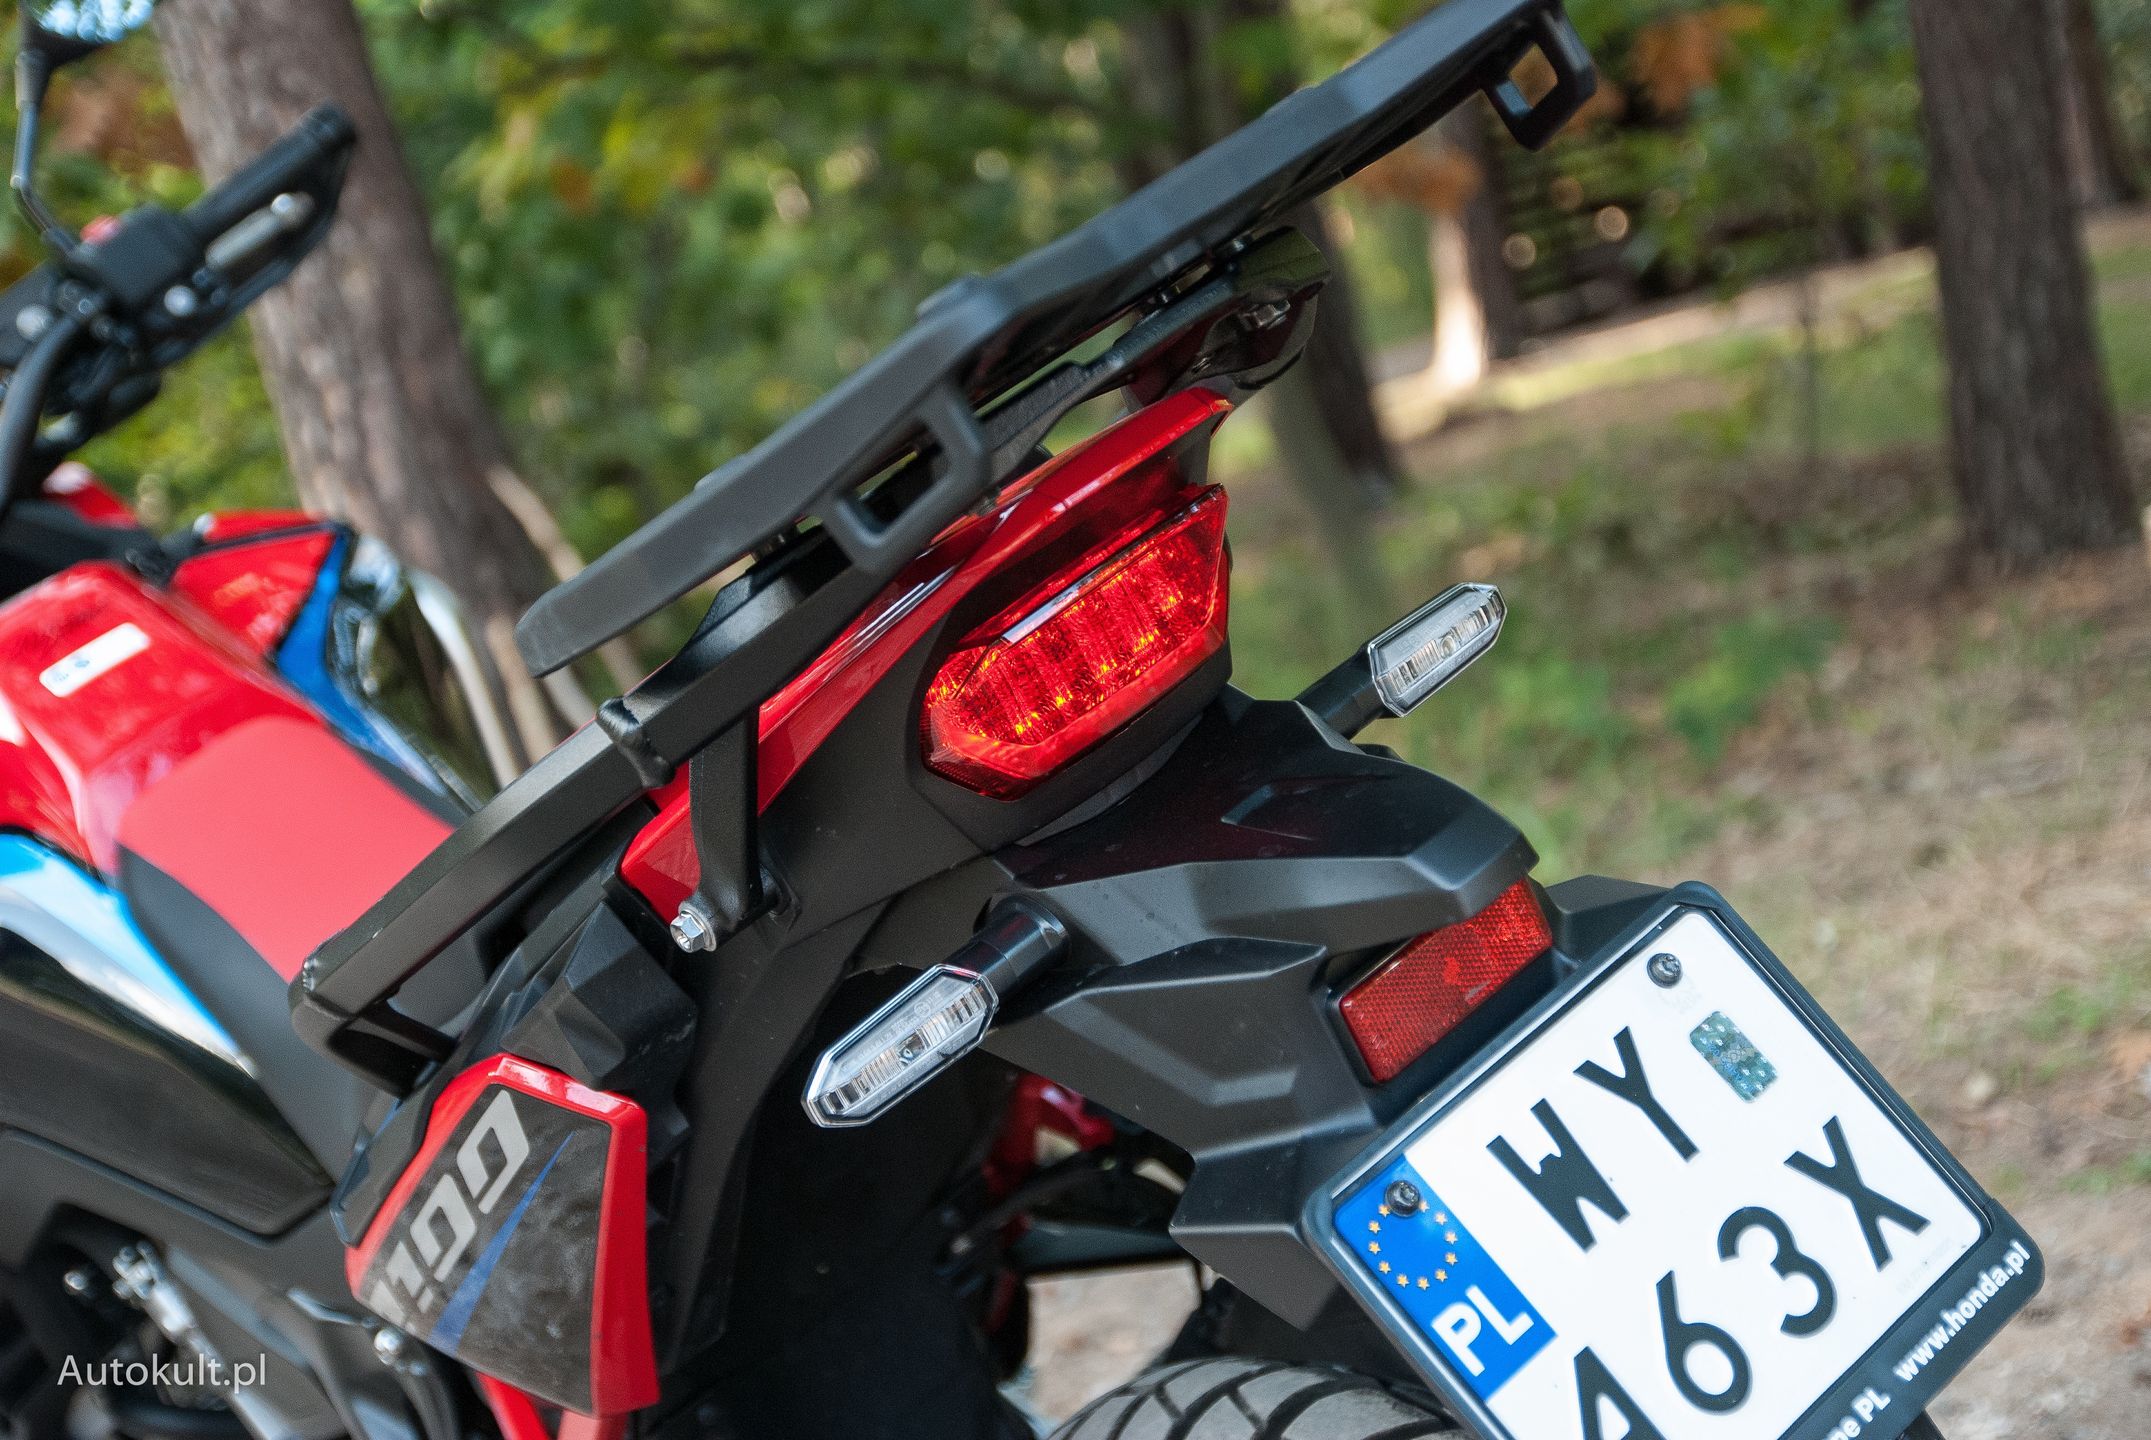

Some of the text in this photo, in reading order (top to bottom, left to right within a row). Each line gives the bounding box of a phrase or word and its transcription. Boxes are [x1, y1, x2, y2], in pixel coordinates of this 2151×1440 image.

[1486, 1025, 1700, 1253] WY
[1431, 1284, 1535, 1377] PL
[1572, 1115, 1932, 1440] A63X
[1851, 1387, 1892, 1422] PL
[1892, 1239, 2031, 1383] www.honda.pl
